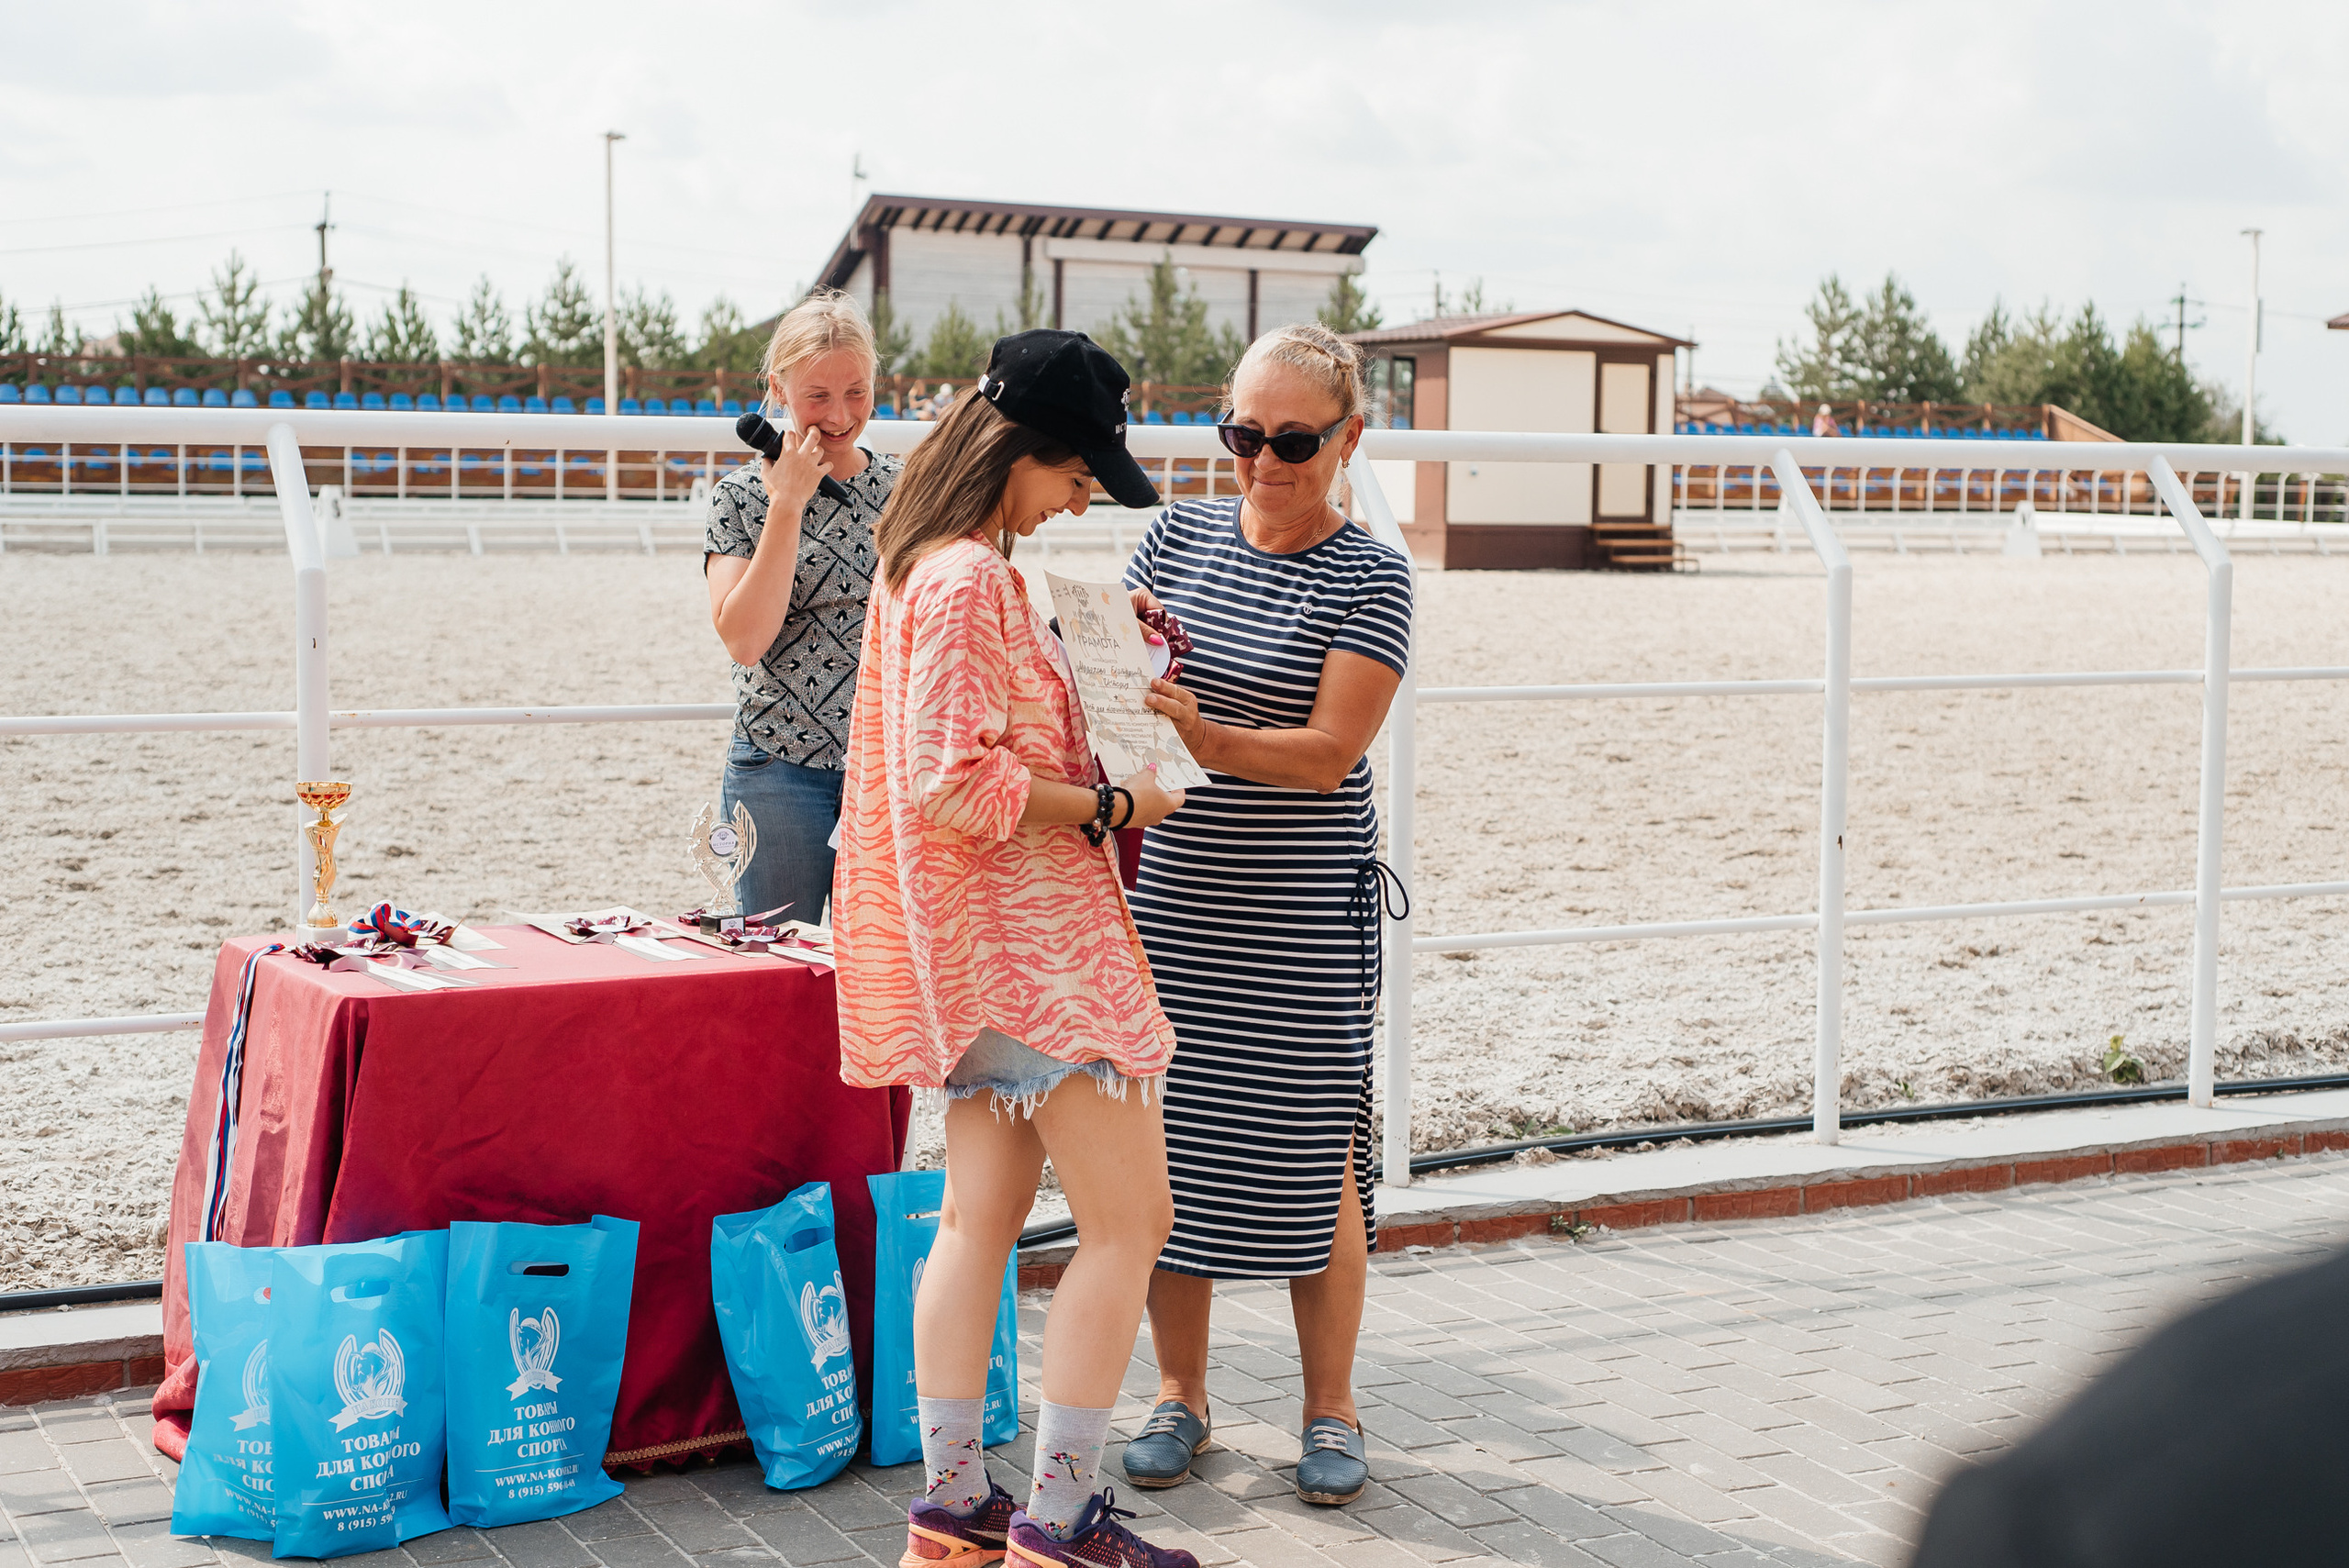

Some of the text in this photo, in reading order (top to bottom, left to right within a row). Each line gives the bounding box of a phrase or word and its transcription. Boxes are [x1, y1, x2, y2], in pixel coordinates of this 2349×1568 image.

[514, 1401, 558, 1420] ТОВАРЫ
[806, 1397, 835, 1420] ДЛЯ
[487, 1426, 524, 1447] ДЛЯ
[517, 1438, 568, 1458] СПОРТА
[316, 1458, 355, 1479] ДЛЯ
[508, 1489, 515, 1499] 8
[518, 1485, 544, 1498] (915)
[337, 1518, 376, 1531] 8 (915)
